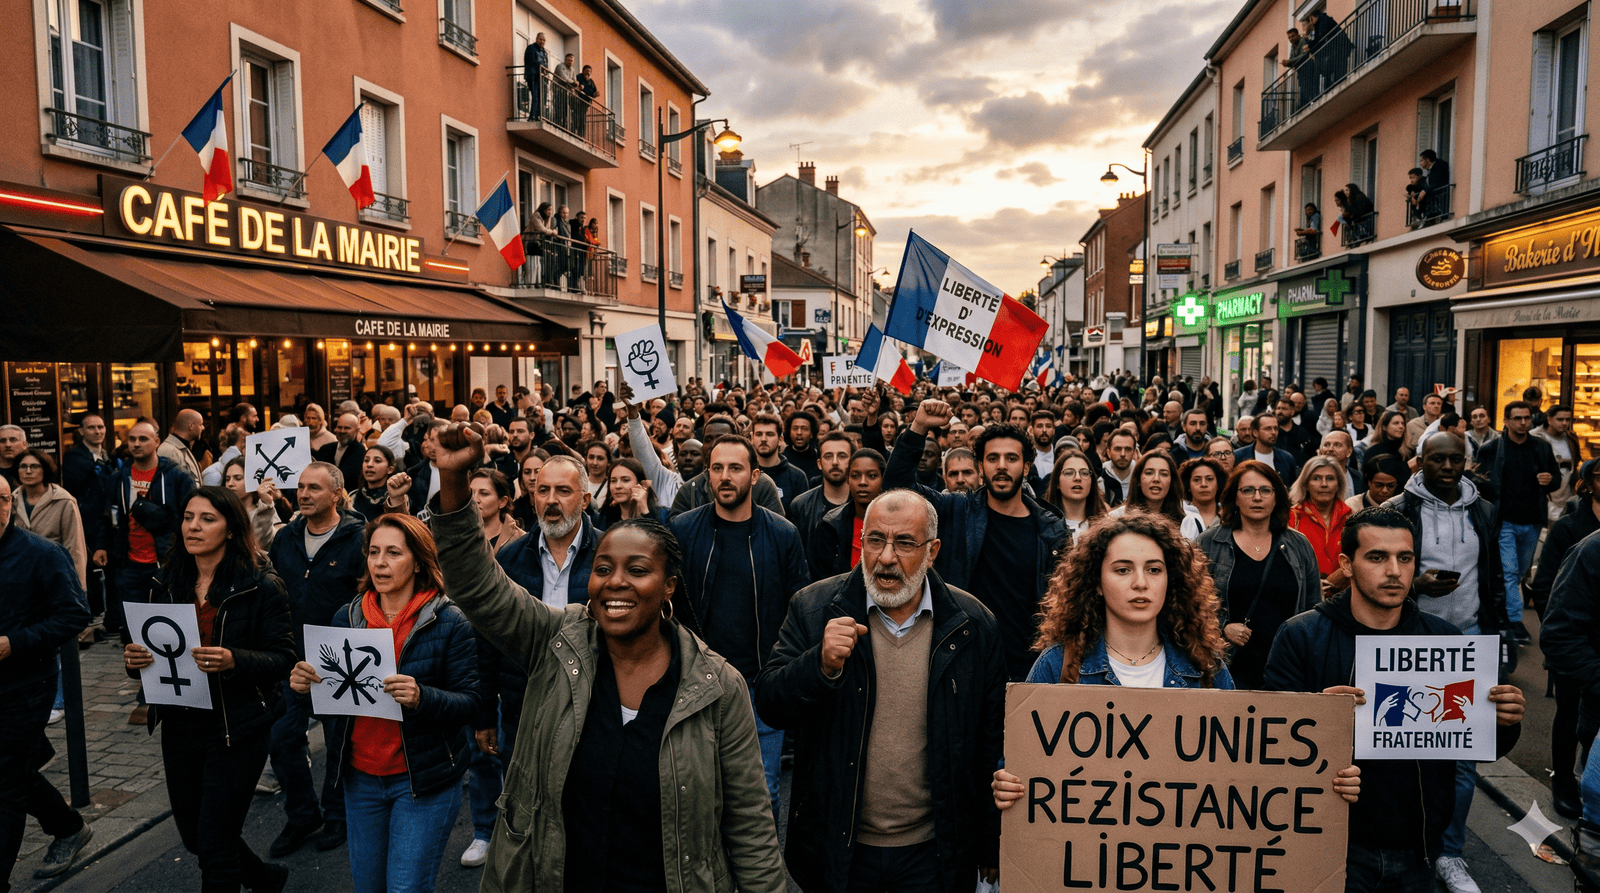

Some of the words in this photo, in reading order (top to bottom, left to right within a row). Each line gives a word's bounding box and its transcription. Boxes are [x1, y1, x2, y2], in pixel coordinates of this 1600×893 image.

[239, 206, 285, 254] DE
[292, 216, 333, 261] LA
[336, 225, 421, 273] MAIRIE
[1504, 238, 1560, 272] Bakerie
[942, 277, 1000, 313] LIBERTÉ
[1216, 292, 1264, 320] PHARMACY
[355, 319, 385, 336] CAFE
[386, 321, 401, 336] DE
[403, 322, 417, 337] LA
[418, 323, 450, 338] MAIRIE
[958, 306, 973, 321] D'
[916, 306, 1004, 358] D'EXPRESSION
[1375, 641, 1476, 672] LIBERTÉ
[1031, 701, 1152, 760] VOIX
[1372, 727, 1473, 749] FRATERNITÉ
[1063, 832, 1286, 893] LIBERTÉ
